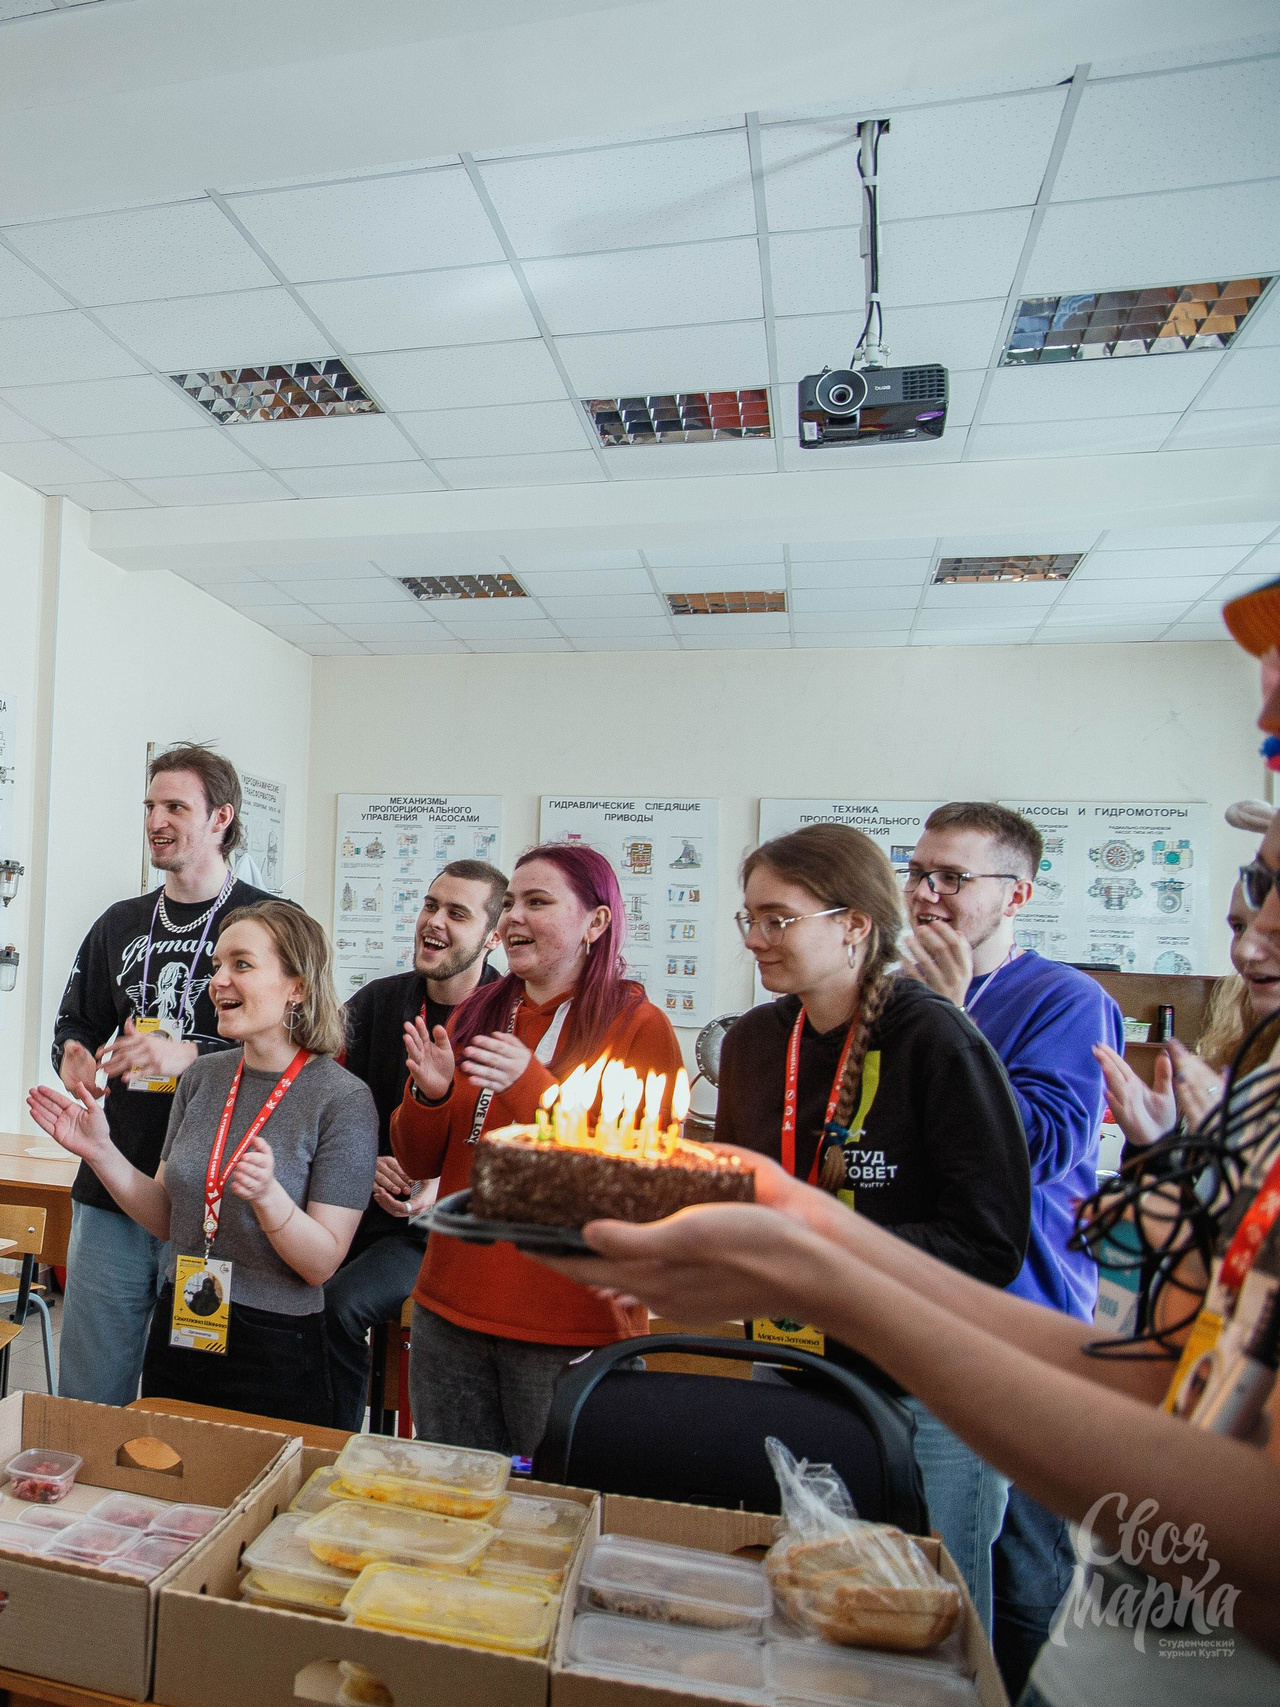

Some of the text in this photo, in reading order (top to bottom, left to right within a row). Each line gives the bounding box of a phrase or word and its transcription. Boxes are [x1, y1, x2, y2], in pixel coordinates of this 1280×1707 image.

[390, 797, 448, 805] МЕХАНИЗМЫ
[549, 801, 701, 812] ГИДРАВЛИЧЕСКИЕ СЛЕДЯЩИЕ
[368, 805, 472, 814] ПРОПОРЦИОНАЛЬНОГО
[832, 805, 879, 814] ТЕХНИКА
[1018, 806, 1068, 816] НАСОСЫ
[1095, 808, 1188, 818] ГИДРОМОТОРЫ
[360, 814, 480, 822] УПРАВЛЕНИЯ НАСОСАМИ
[604, 814, 653, 822] ПРИВОДЫ
[800, 815, 920, 826] ПРОПОРЦИОНАЛЬНОГО
[476, 1093, 492, 1118] LOVE
[213, 1118, 227, 1160] студенческий
[843, 1150, 885, 1166] СТУД
[845, 1165, 898, 1179] ОВЕТ
